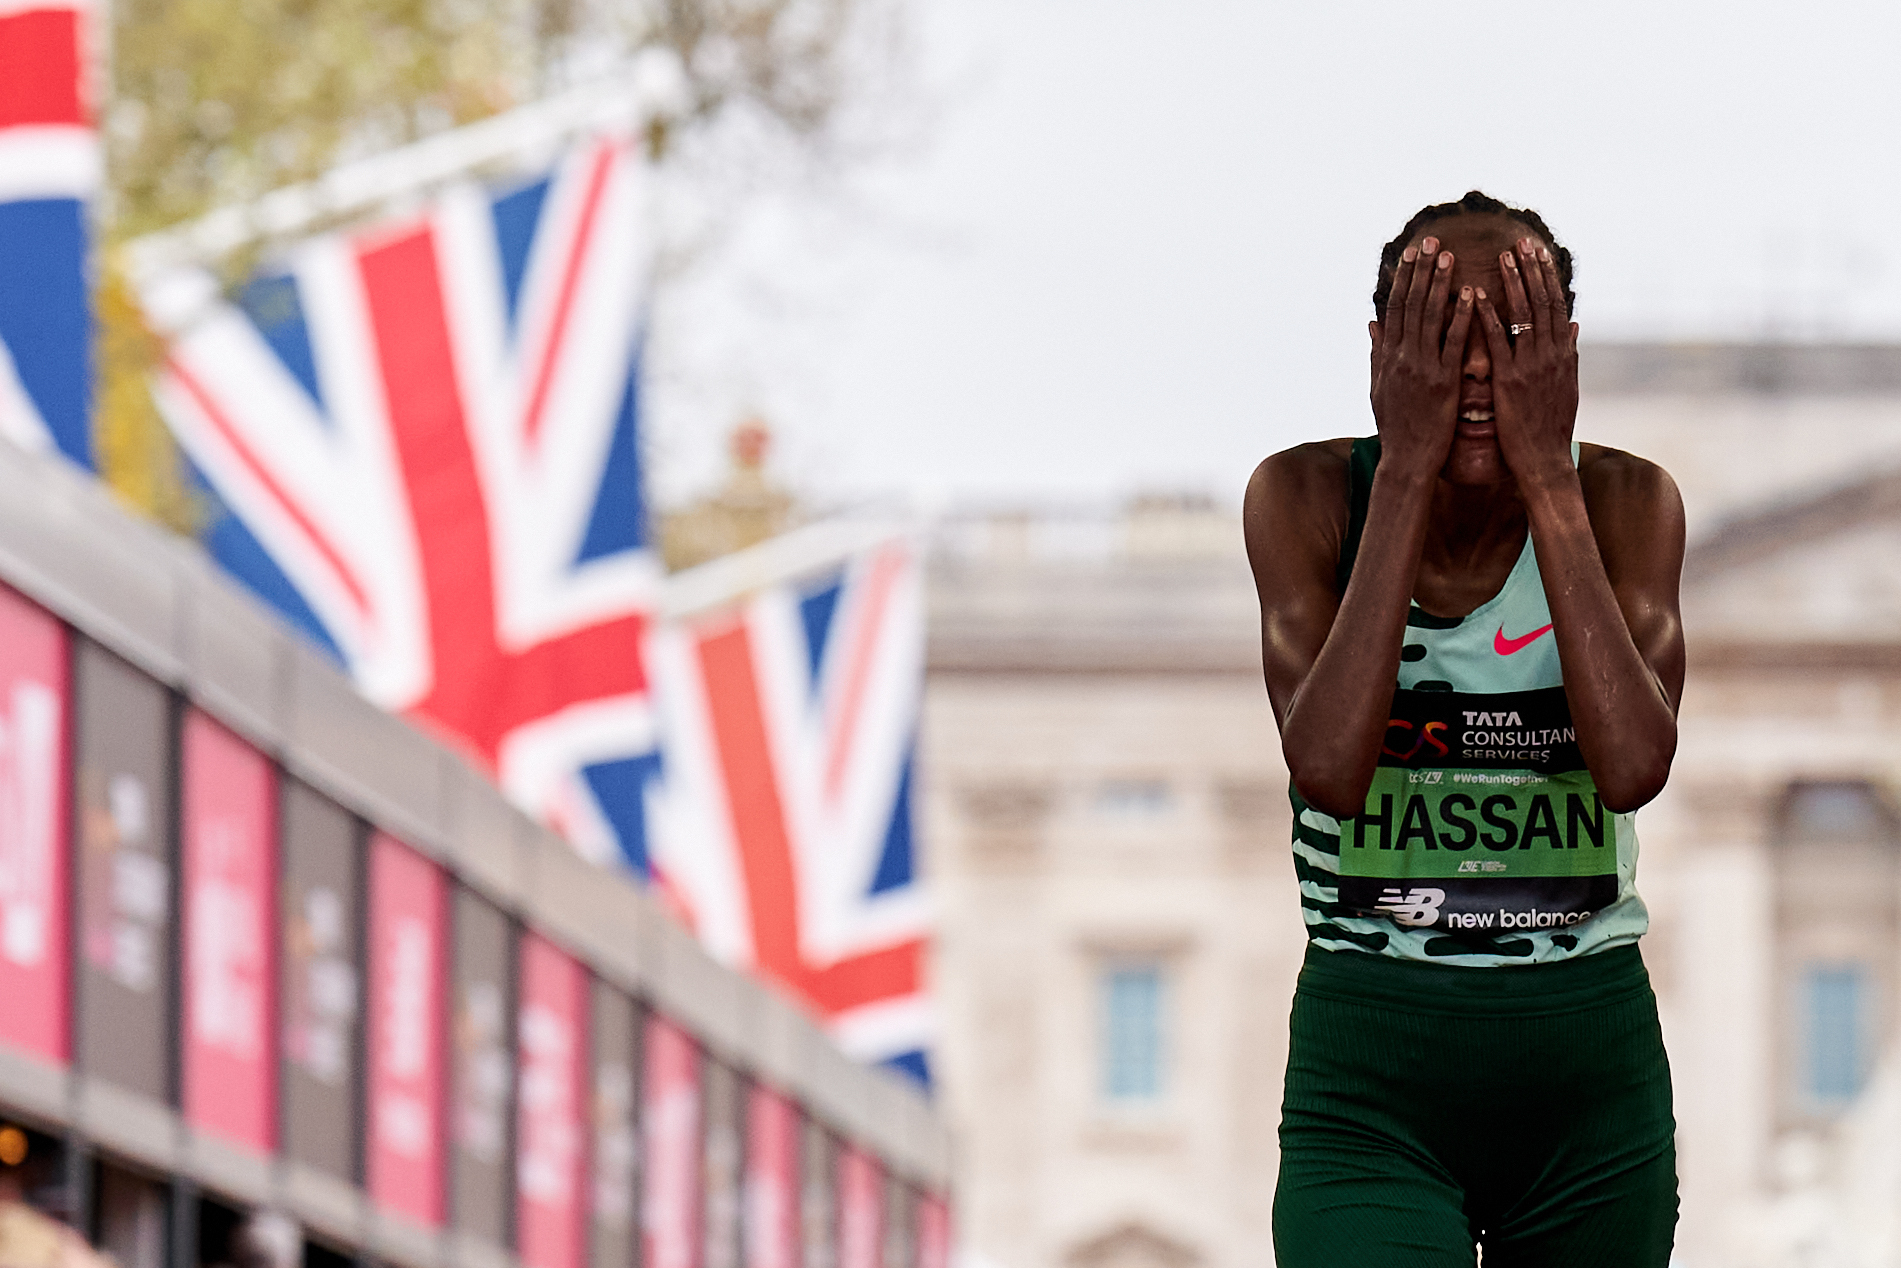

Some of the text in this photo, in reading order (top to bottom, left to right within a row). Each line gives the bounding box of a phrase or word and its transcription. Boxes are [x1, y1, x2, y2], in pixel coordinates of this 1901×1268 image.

[1461, 710, 1523, 727] TATA
[1382, 718, 1449, 761] cs
[1461, 726, 1577, 746] CONSULTAN
[1461, 749, 1551, 763] SERVICES
[1353, 793, 1605, 851] HASSAN
[1448, 908, 1592, 929] new balance
